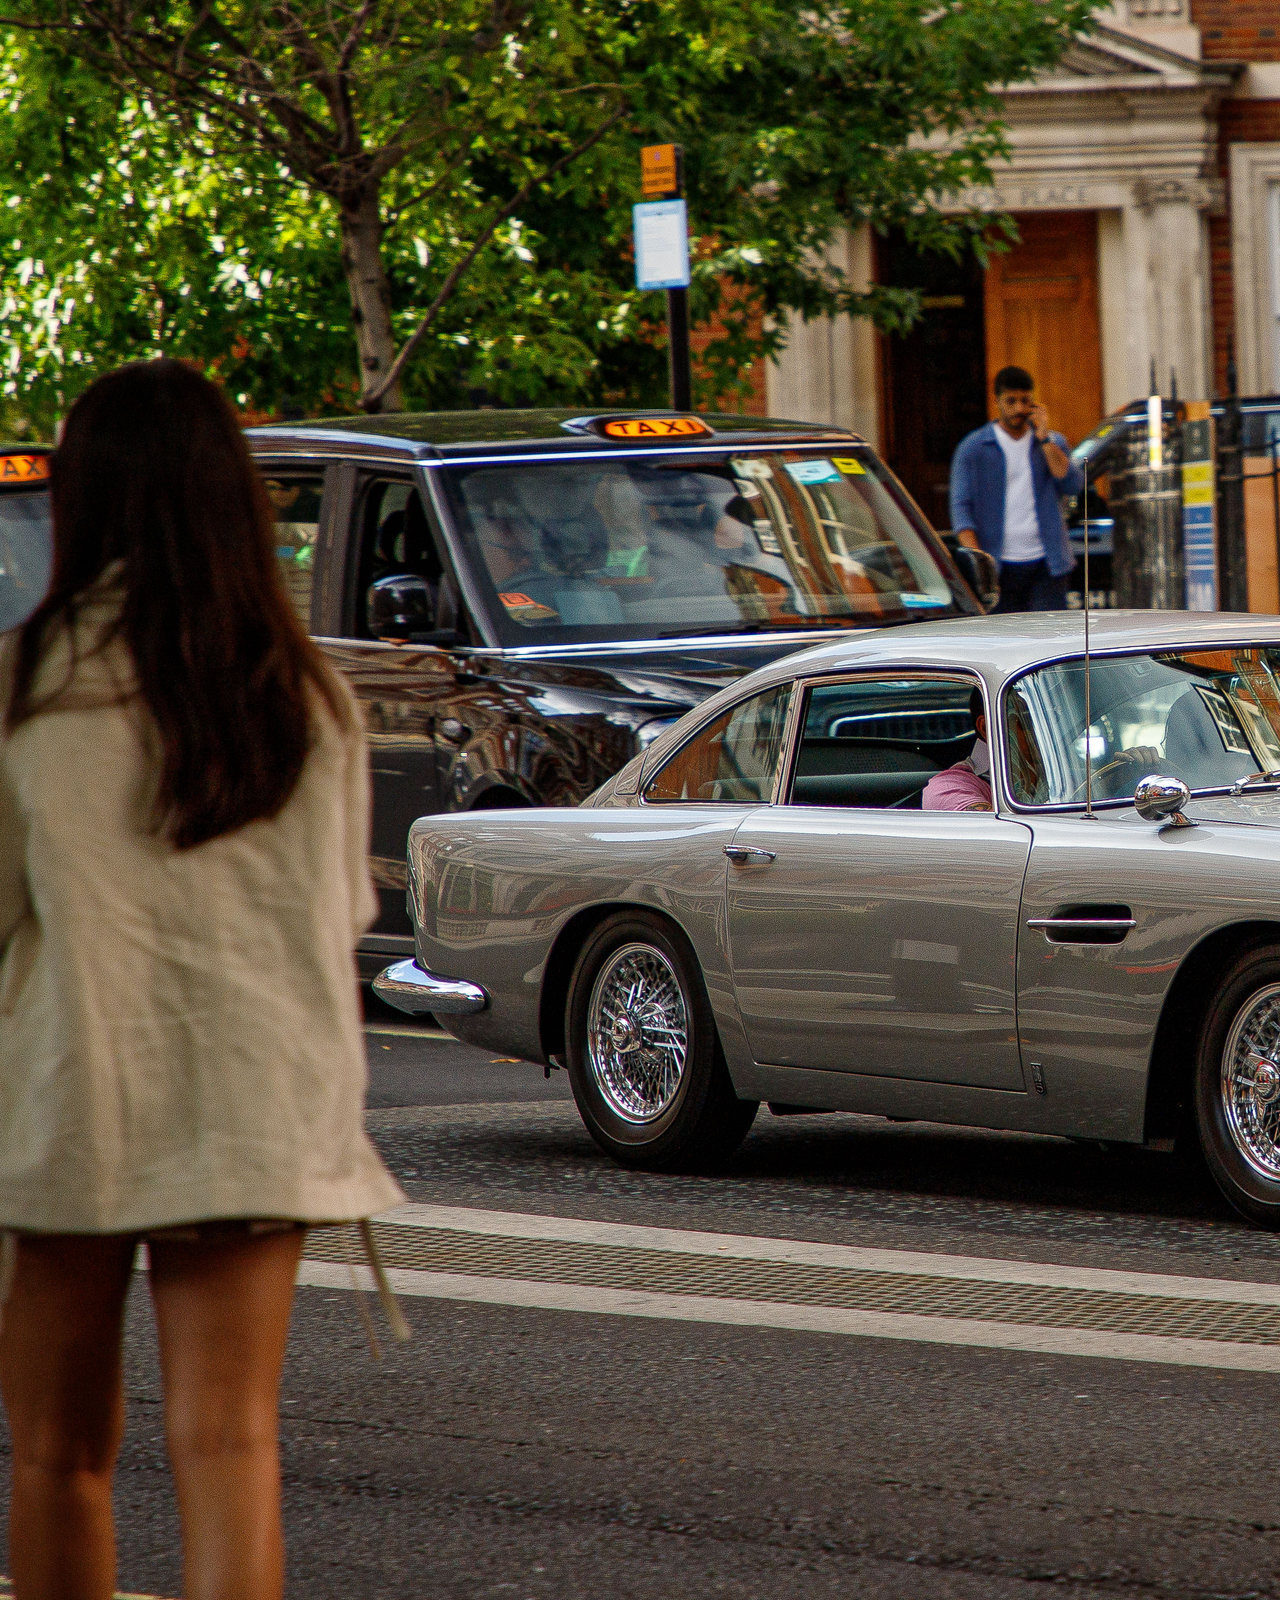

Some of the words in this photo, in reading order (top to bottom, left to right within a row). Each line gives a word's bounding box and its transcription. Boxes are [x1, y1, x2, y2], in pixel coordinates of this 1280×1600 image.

[1021, 183, 1089, 206] PLACE
[614, 421, 697, 435] TAXI
[3, 458, 42, 477] AX
